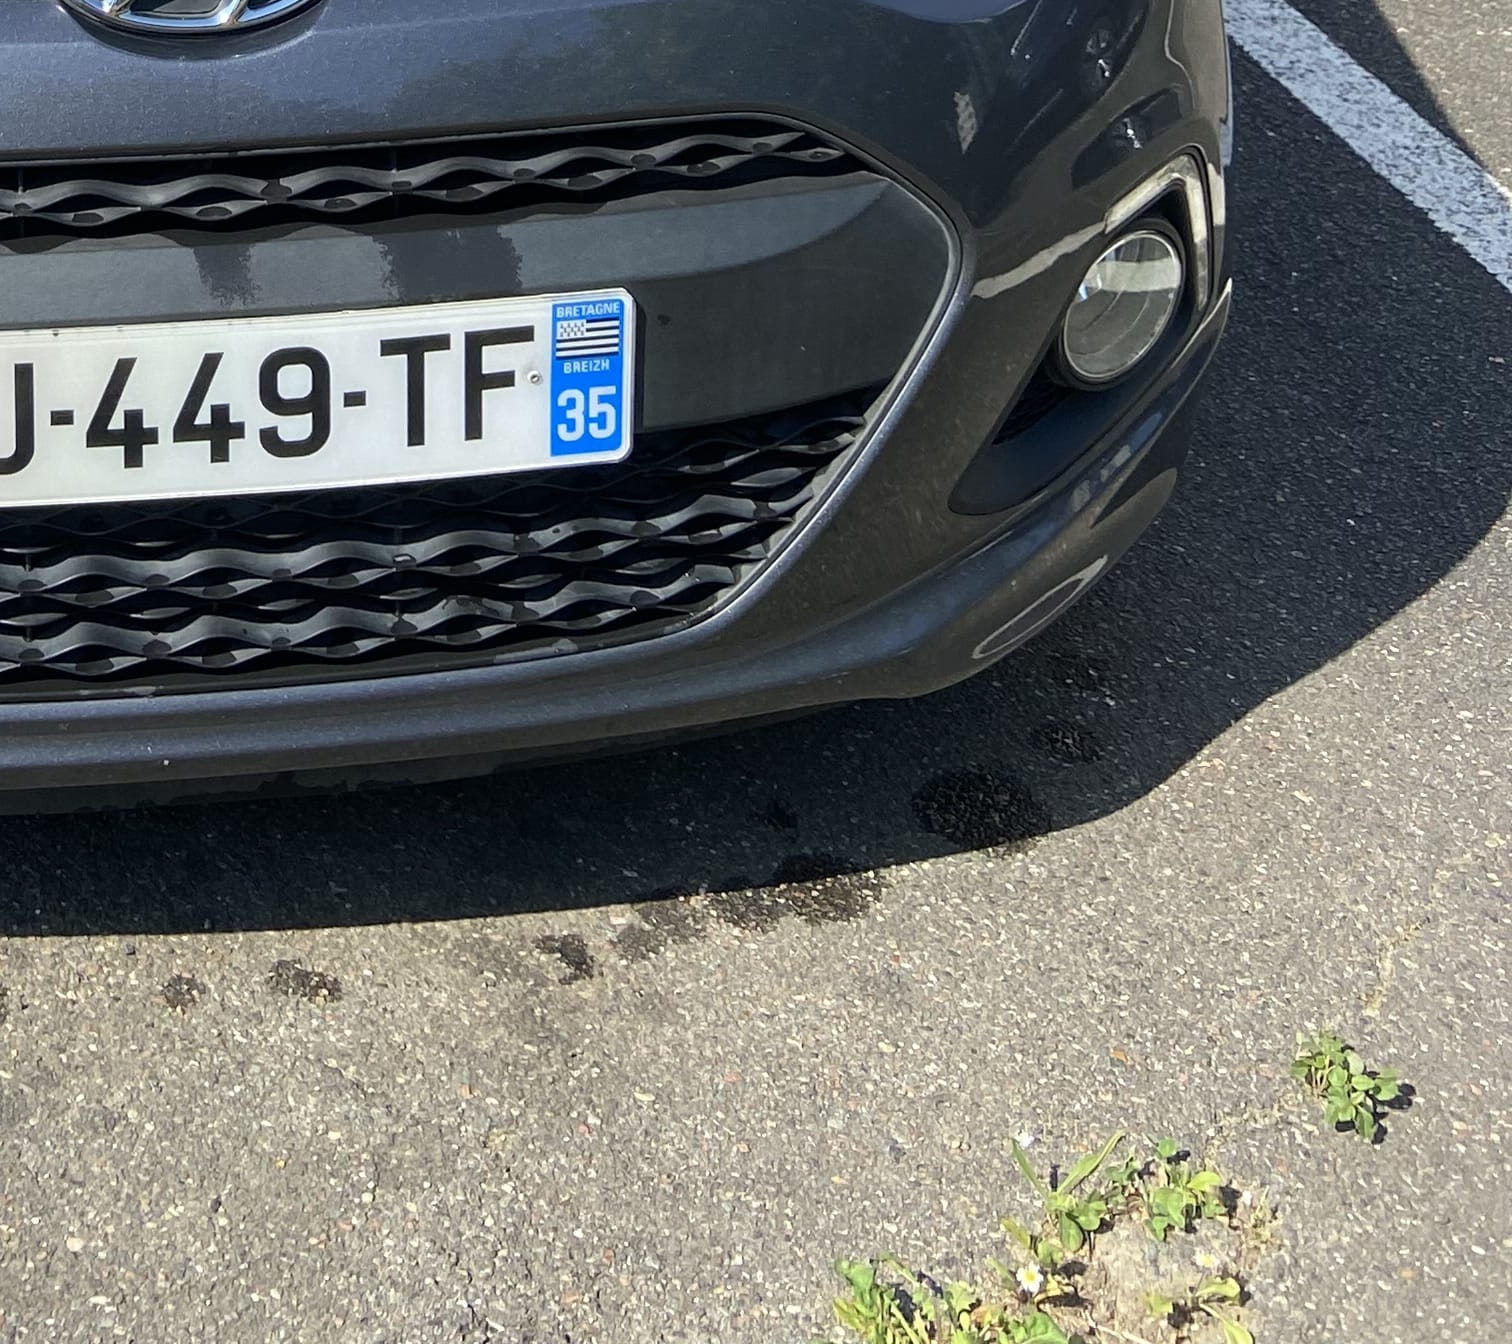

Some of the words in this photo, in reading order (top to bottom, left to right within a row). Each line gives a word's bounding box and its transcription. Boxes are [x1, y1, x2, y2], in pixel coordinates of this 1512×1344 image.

[556, 301, 620, 318] BRETAGNE
[563, 358, 610, 374] BREIZH
[557, 385, 617, 442] 35
